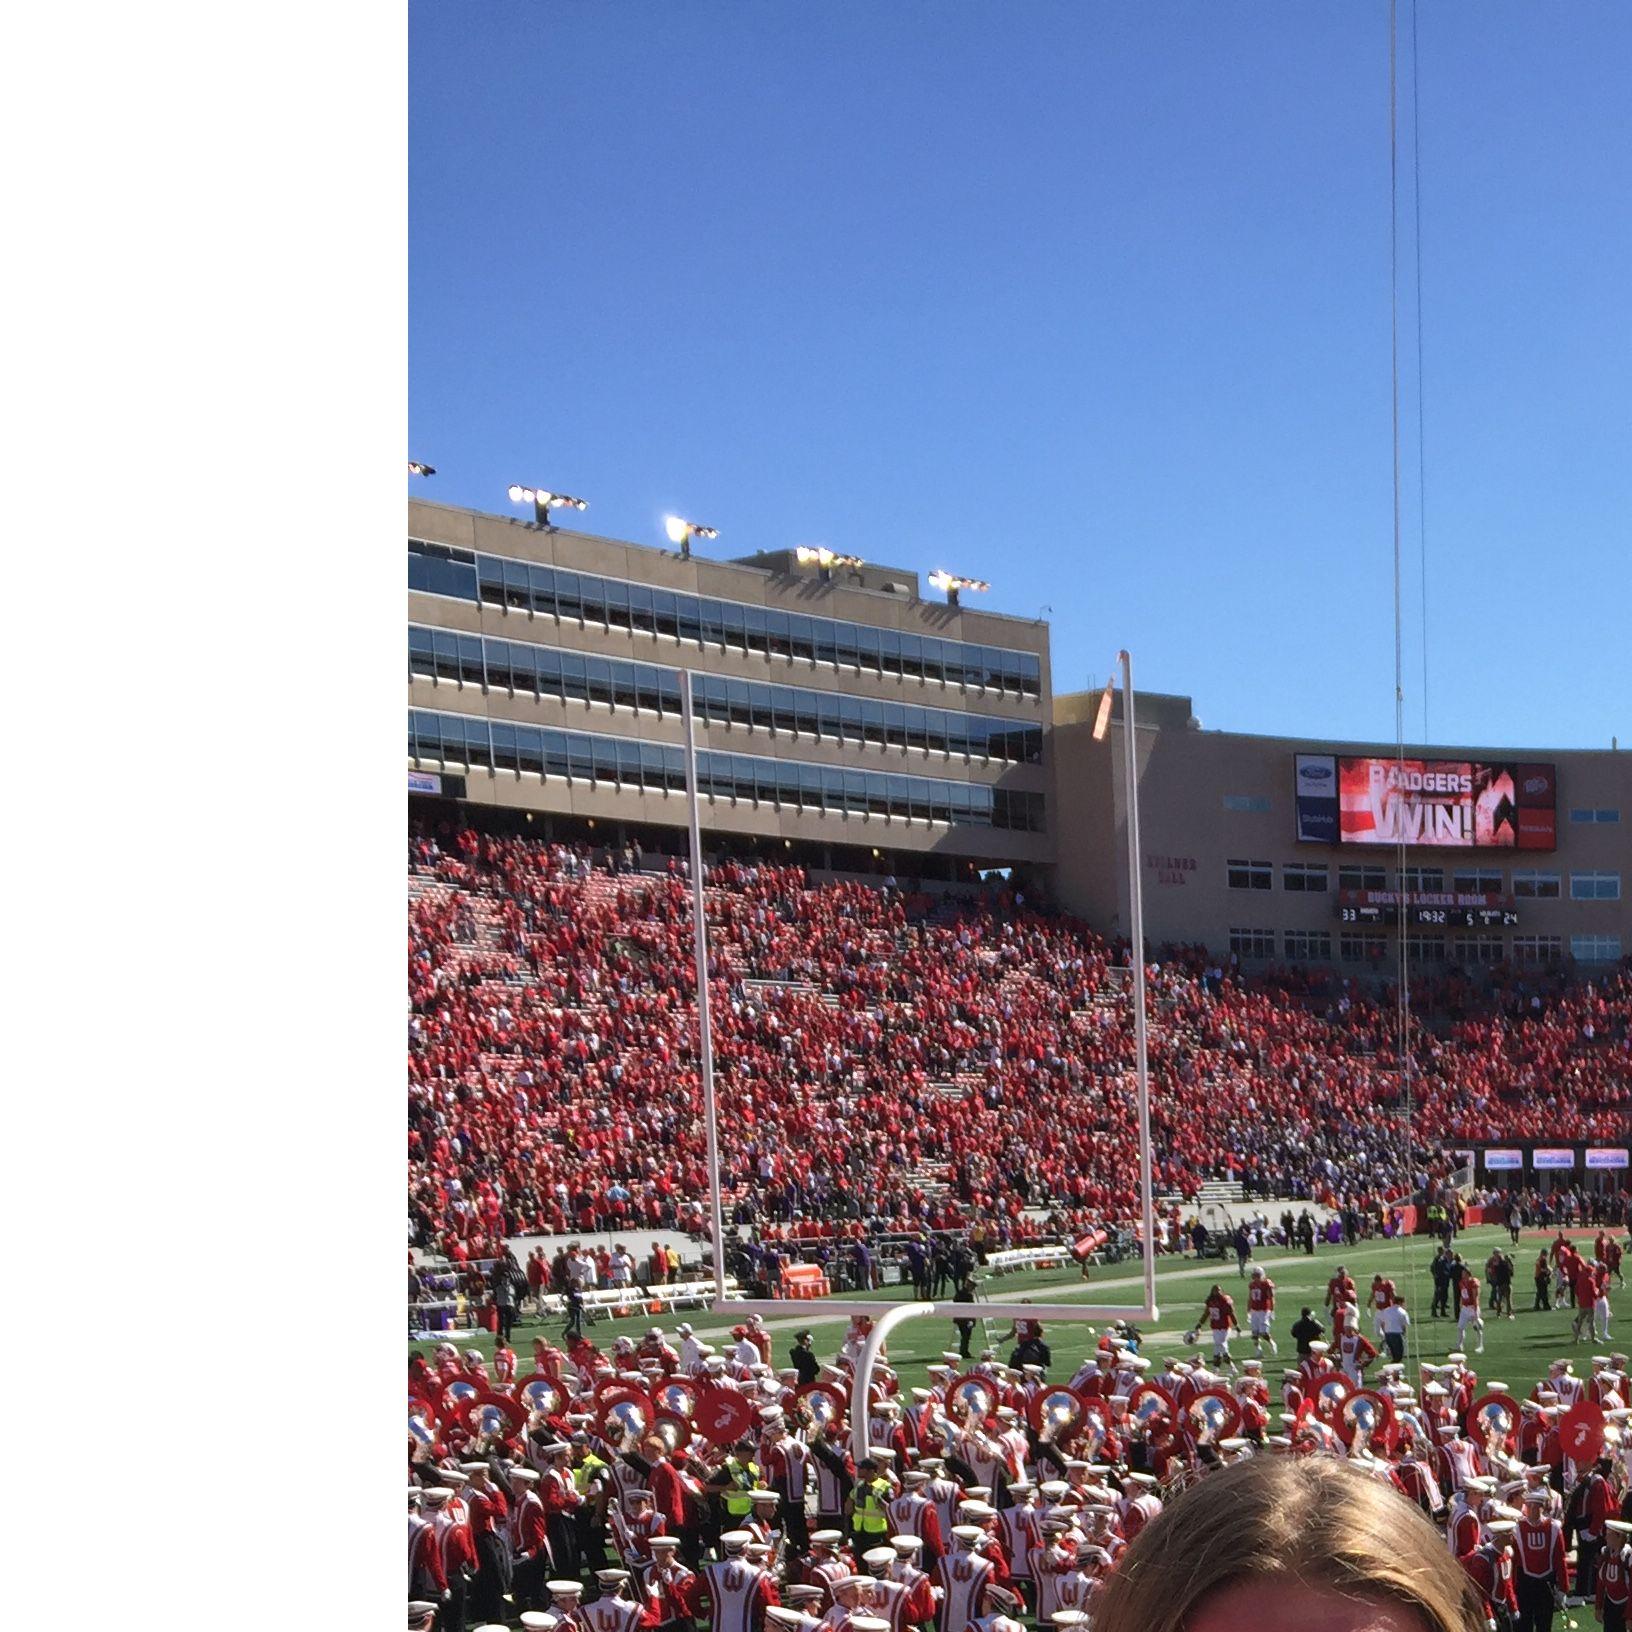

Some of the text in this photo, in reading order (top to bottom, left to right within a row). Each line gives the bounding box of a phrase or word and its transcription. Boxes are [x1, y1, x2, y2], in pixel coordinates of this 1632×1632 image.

[1369, 764, 1473, 793] BADGERS
[1370, 795, 1474, 841] WIN!
[1413, 892, 1455, 905] LOCKER
[1458, 893, 1487, 906] ROOM
[1342, 908, 1356, 921] 33
[1503, 912, 1518, 924] 24
[723, 1566, 746, 1593] W
